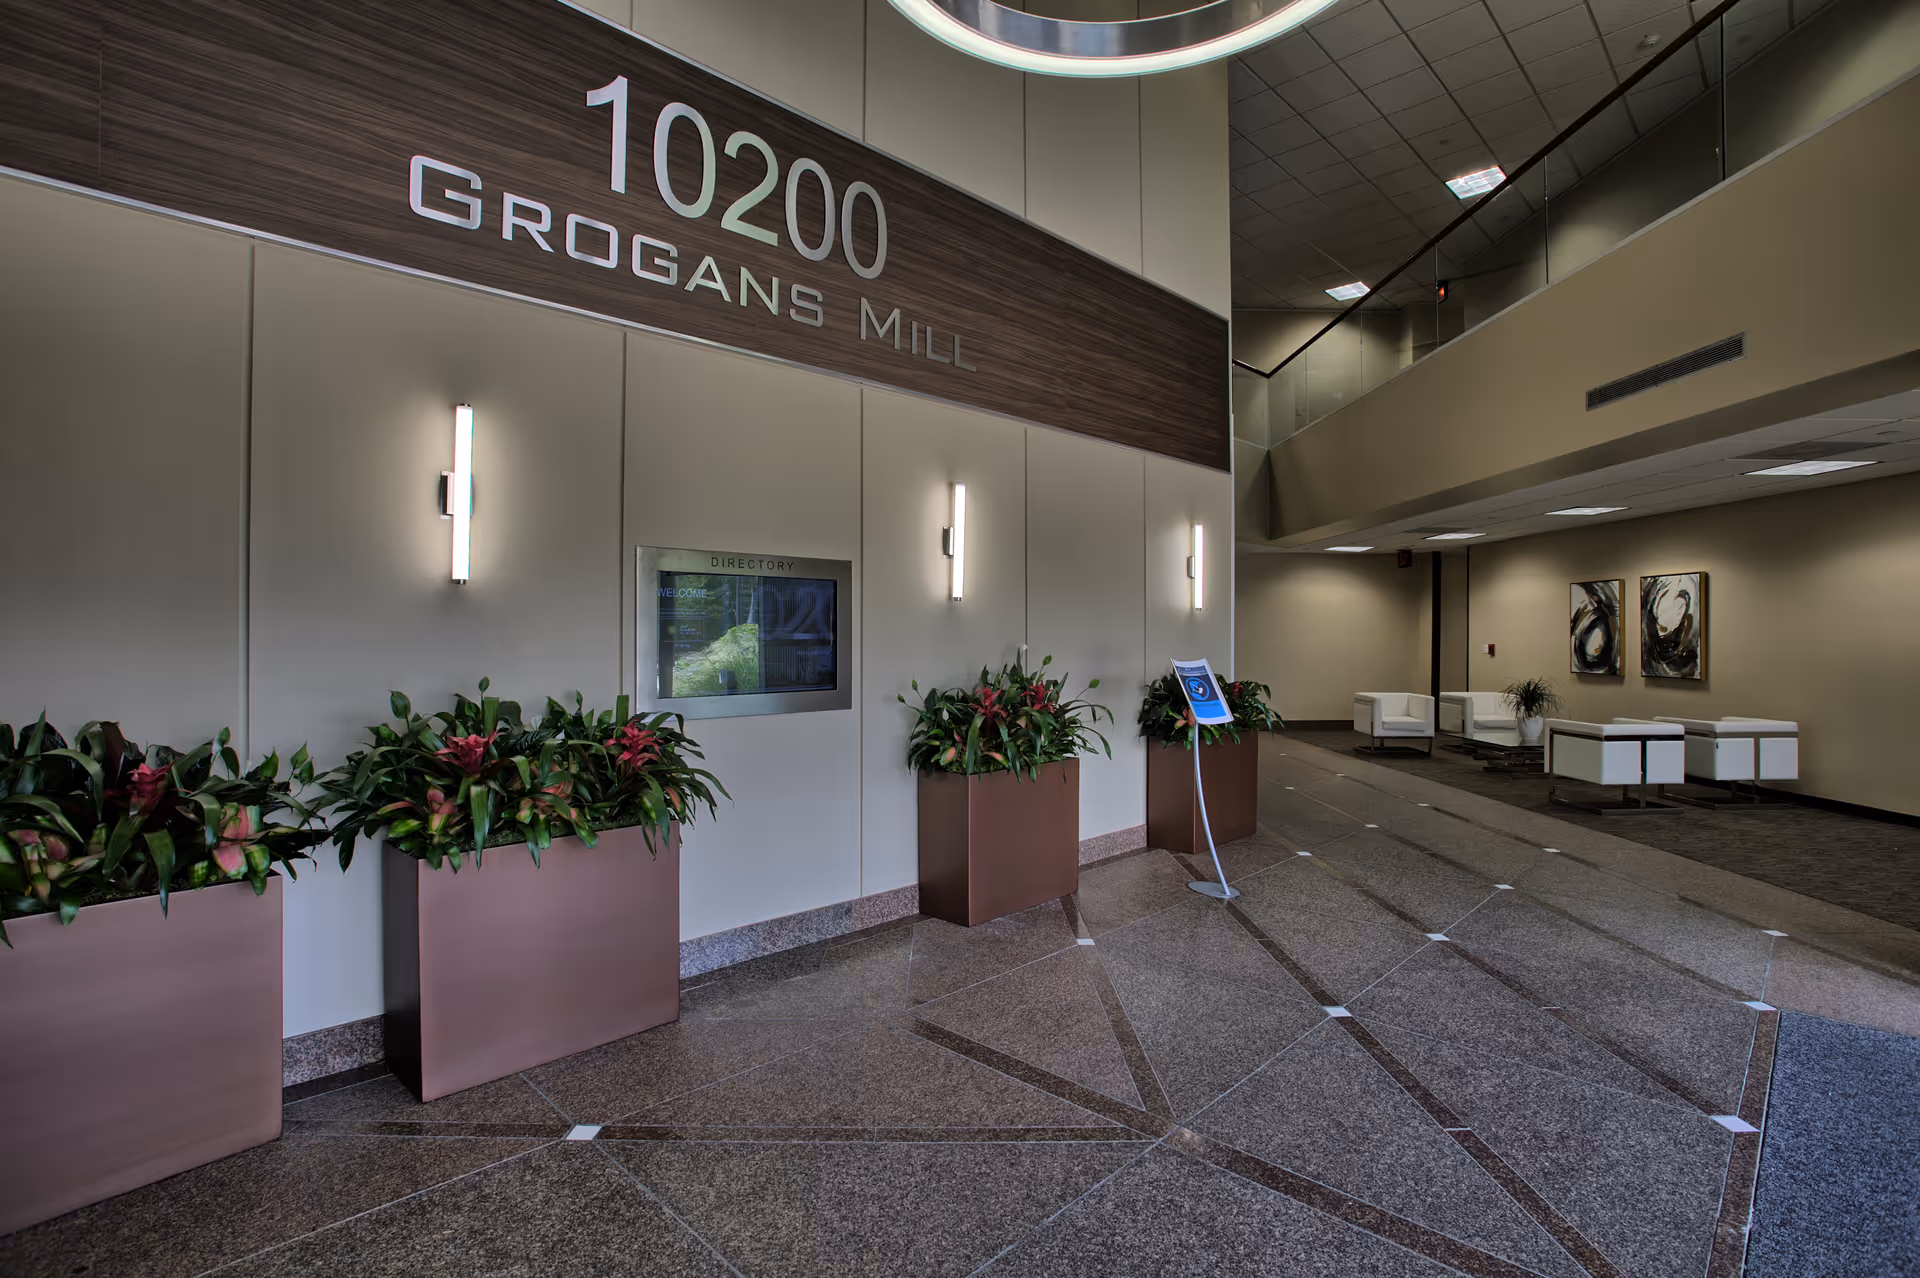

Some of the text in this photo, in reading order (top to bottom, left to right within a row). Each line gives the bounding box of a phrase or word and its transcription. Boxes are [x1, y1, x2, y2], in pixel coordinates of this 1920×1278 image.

[586, 75, 888, 279] 10200
[409, 155, 977, 372] GROGANS MILL
[657, 587, 708, 598] WELCOME
[711, 557, 794, 571] DIRECTORY
